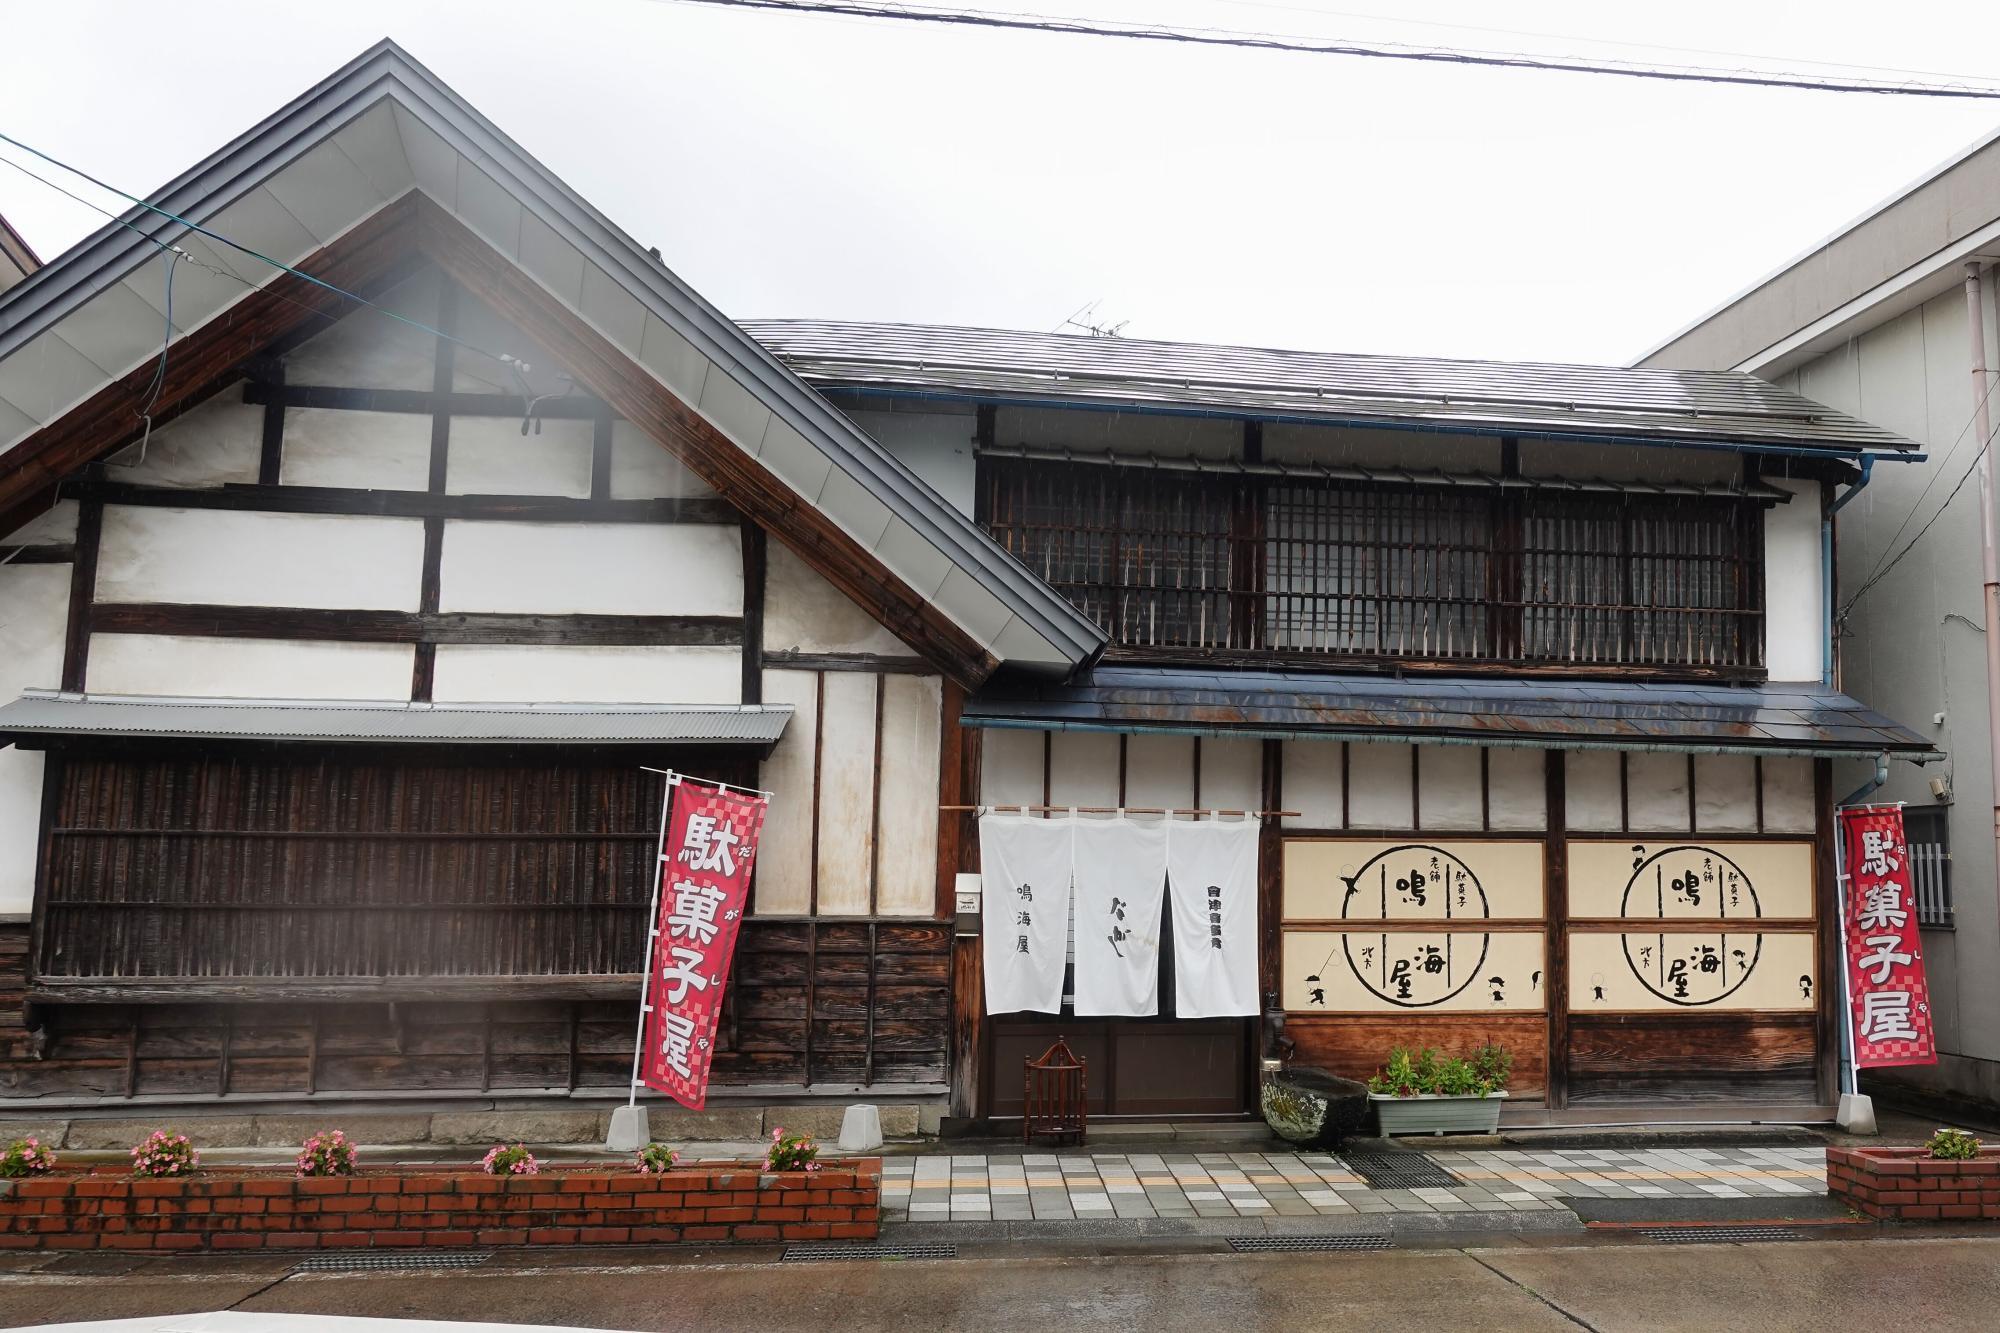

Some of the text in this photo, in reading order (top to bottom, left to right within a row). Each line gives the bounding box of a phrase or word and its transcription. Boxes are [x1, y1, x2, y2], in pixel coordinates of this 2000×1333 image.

[663, 814, 738, 1078] 駄菓子屋
[1016, 883, 1032, 954] 鳴海屋
[1108, 897, 1132, 958] だがし
[1858, 830, 1917, 1041] 駄菓子屋
